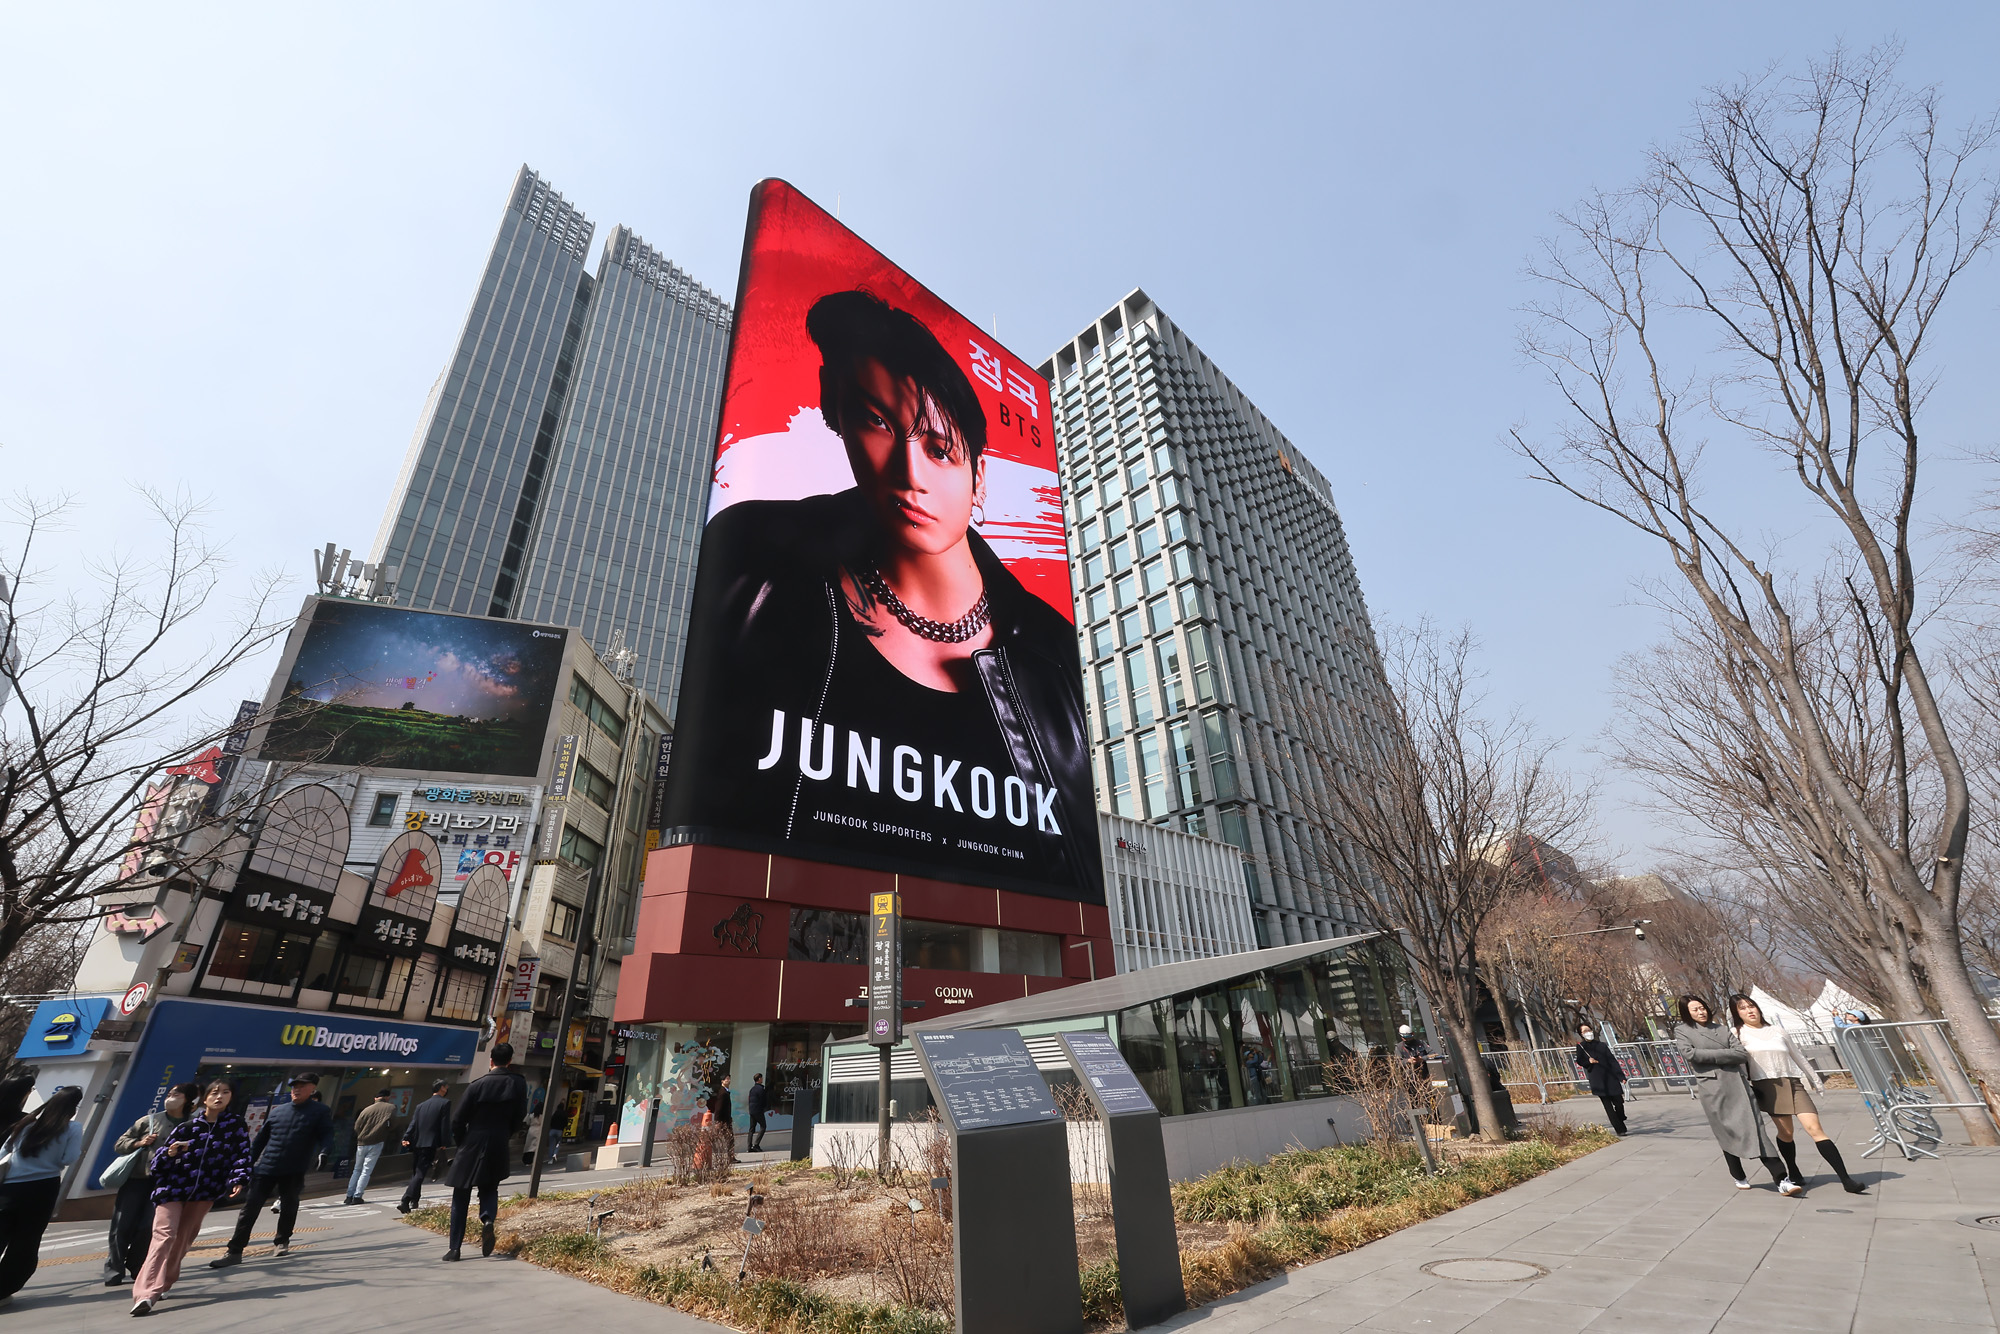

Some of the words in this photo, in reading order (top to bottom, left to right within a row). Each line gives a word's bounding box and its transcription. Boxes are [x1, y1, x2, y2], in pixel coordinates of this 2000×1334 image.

[968, 338, 1039, 420] 정국
[1000, 402, 1041, 448] BTS
[659, 742, 673, 777] 한의원
[757, 708, 1063, 836] JUNGKOOK
[404, 810, 523, 835] 강비뇨기과
[813, 810, 868, 830] JUNGKOOK
[872, 821, 932, 843] SUPPORTERS
[956, 838, 999, 856] JUNGKOOK
[1002, 847, 1025, 860] CHINA
[452, 833, 511, 850] 피부과
[374, 919, 417, 947] 청담동
[878, 916, 887, 929] 7
[874, 941, 884, 982] 광화문
[513, 962, 536, 1001] 약국
[935, 986, 974, 999] GODIVA
[126, 991, 143, 1008] 30
